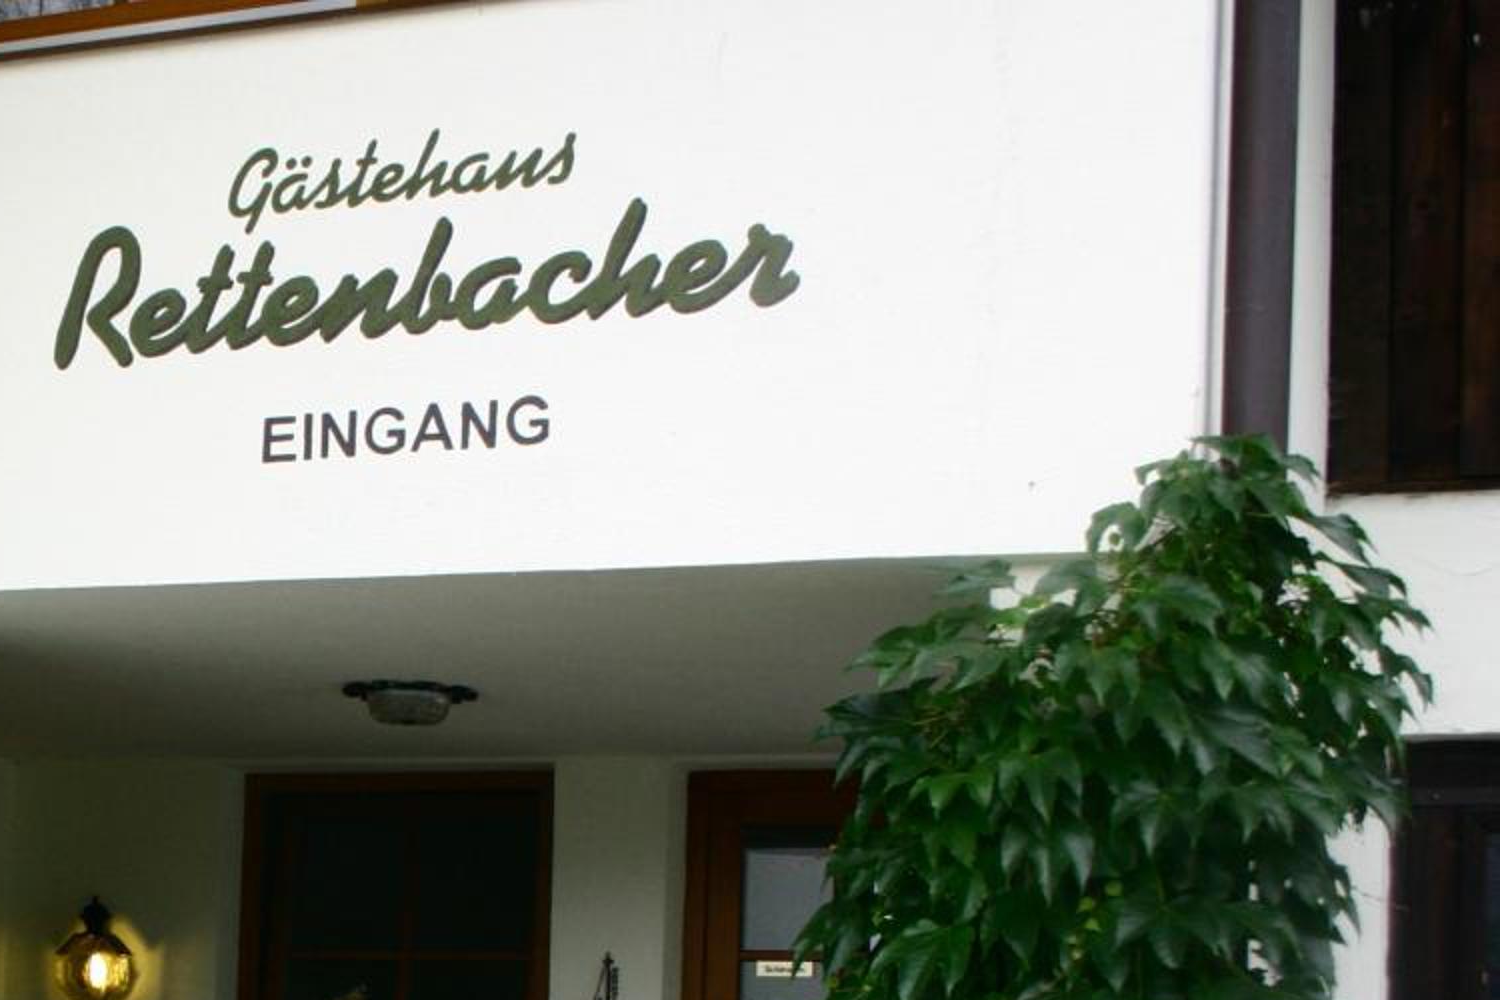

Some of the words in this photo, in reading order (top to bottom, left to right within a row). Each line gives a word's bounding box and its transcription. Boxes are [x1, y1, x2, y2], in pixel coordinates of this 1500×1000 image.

[228, 128, 577, 235] Gästehaus
[53, 197, 800, 370] Rettenbacher
[262, 395, 550, 463] EINGANG
